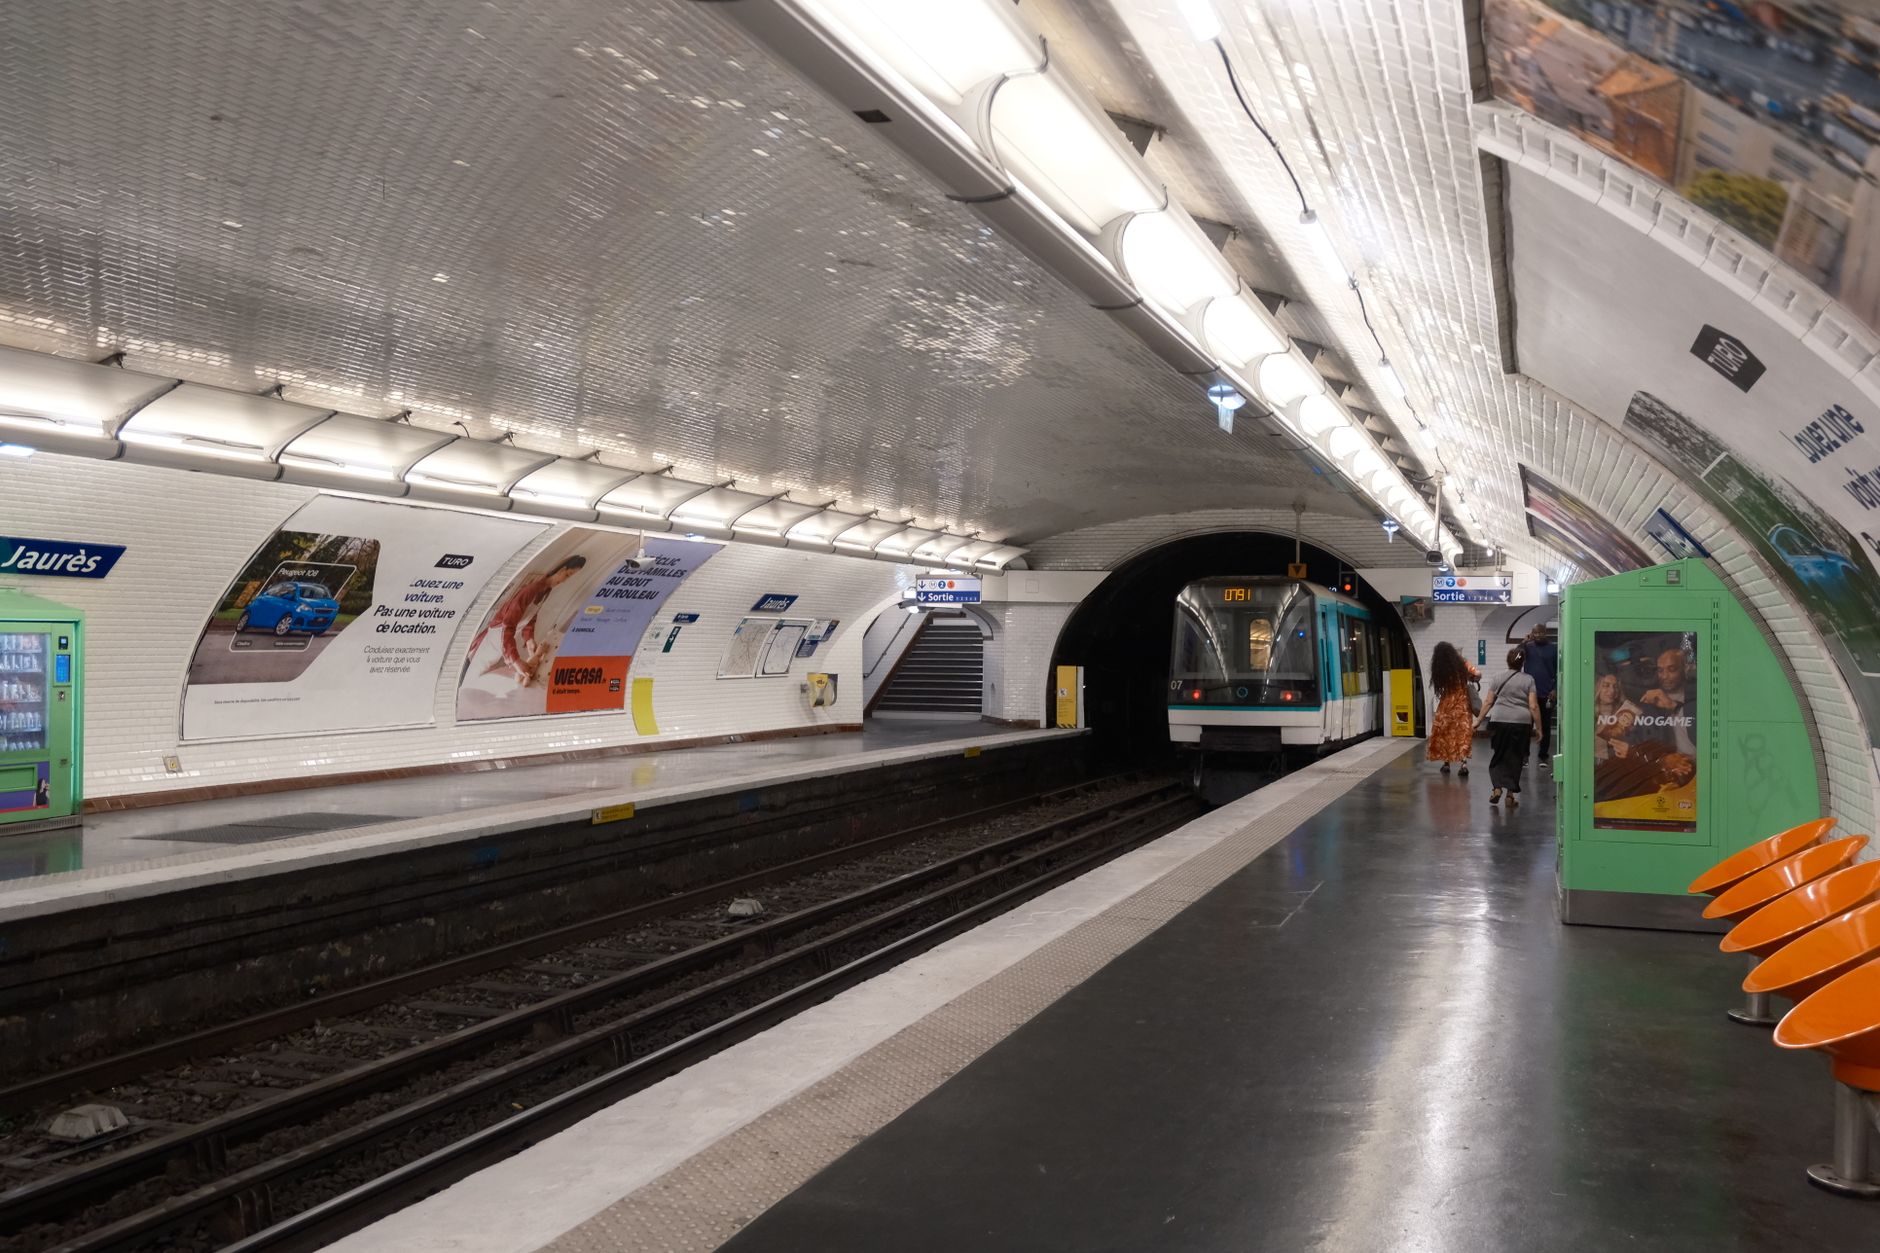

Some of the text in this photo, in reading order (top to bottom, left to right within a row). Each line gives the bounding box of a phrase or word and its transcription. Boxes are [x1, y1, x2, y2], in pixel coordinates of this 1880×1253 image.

[1707, 337, 1748, 377] TURO
[1817, 404, 1864, 443] une
[1, 545, 102, 573] Jaurès
[442, 557, 469, 566] TURO
[441, 580, 464, 590] une
[606, 576, 653, 588] AU BOUT
[404, 590, 444, 603] voiture.
[596, 588, 659, 599] DU ROULEAU
[927, 592, 954, 602] Sortie
[1224, 588, 1251, 601] 0791
[1433, 591, 1465, 601] Sortie
[373, 605, 456, 619] Pas une voiture
[376, 620, 437, 634] de location.
[1170, 681, 1183, 690] 07
[1597, 715, 1692, 727] NO NO GAME
